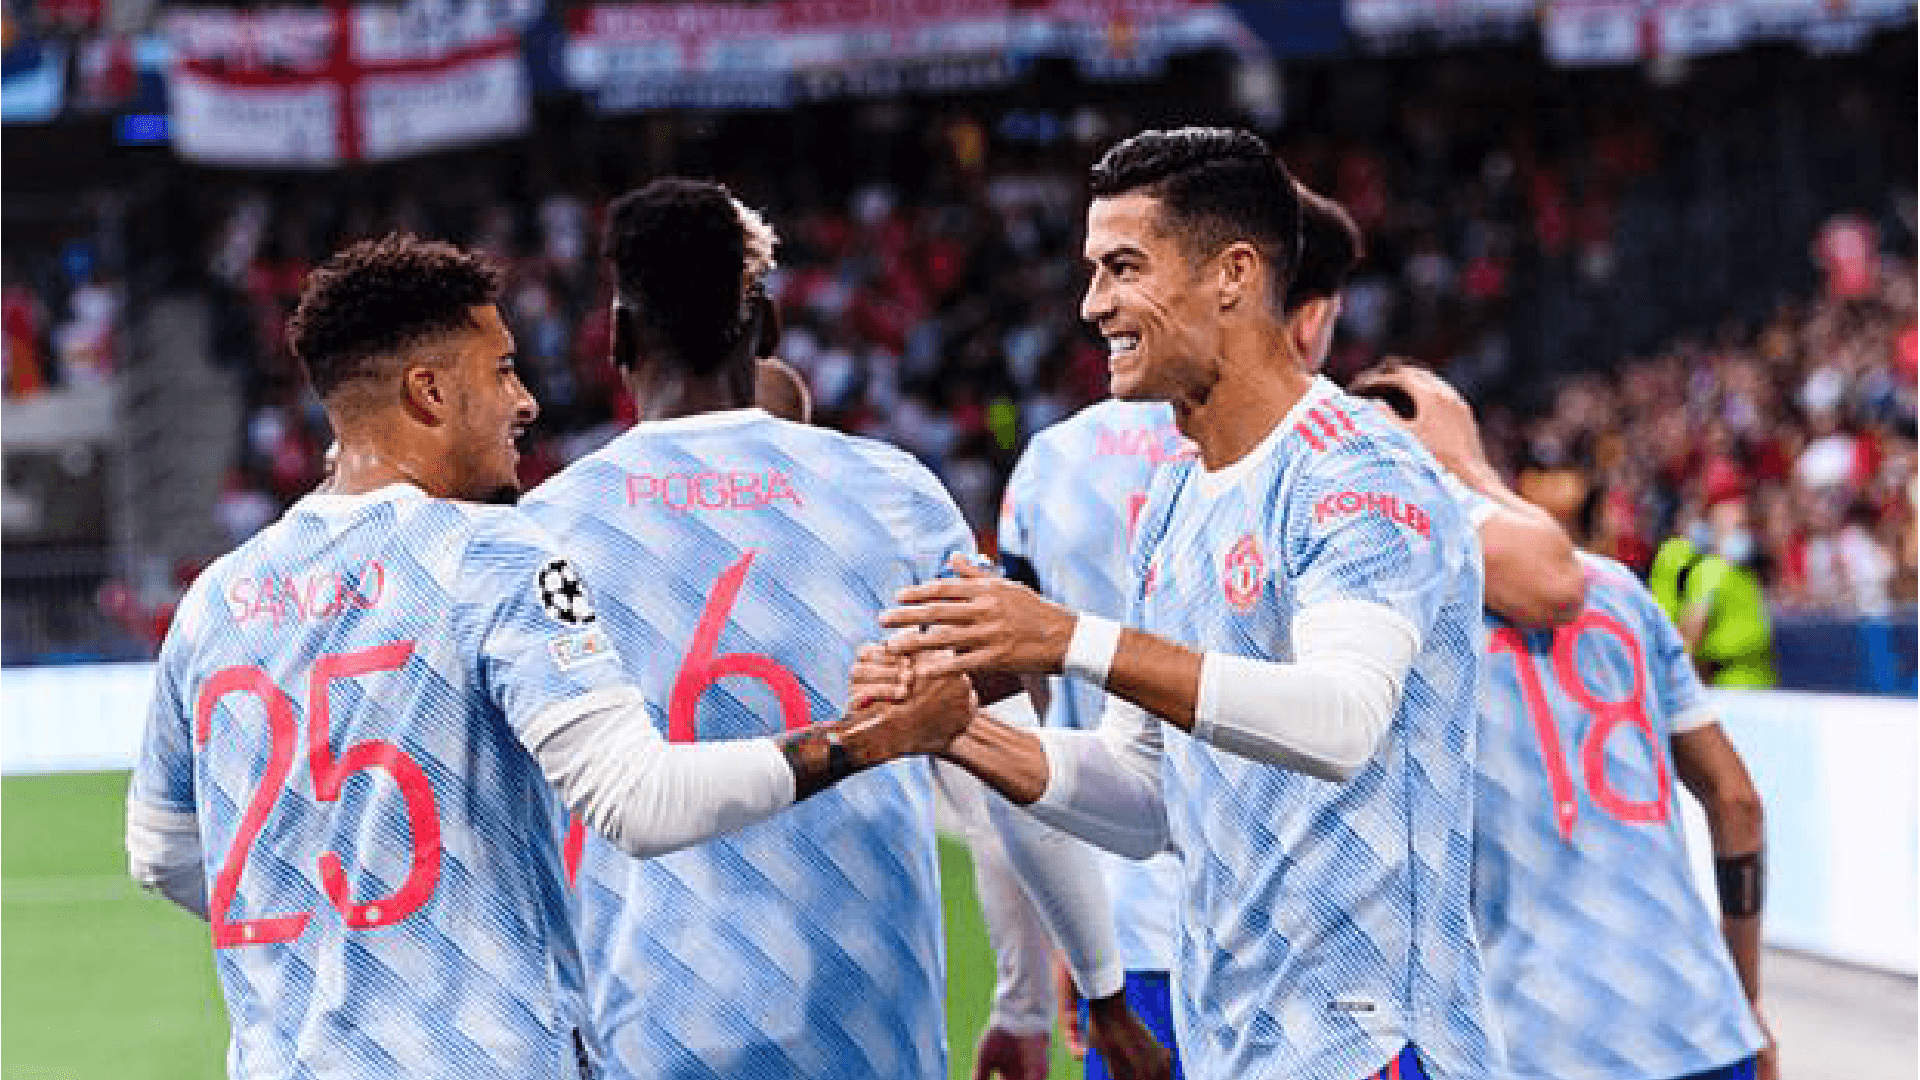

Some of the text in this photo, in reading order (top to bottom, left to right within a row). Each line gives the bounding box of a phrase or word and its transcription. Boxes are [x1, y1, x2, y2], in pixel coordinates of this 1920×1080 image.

[626, 469, 804, 510] POGBA
[1312, 491, 1431, 539] KOHLER
[195, 640, 441, 948] 25
[1486, 608, 1670, 843] 18
